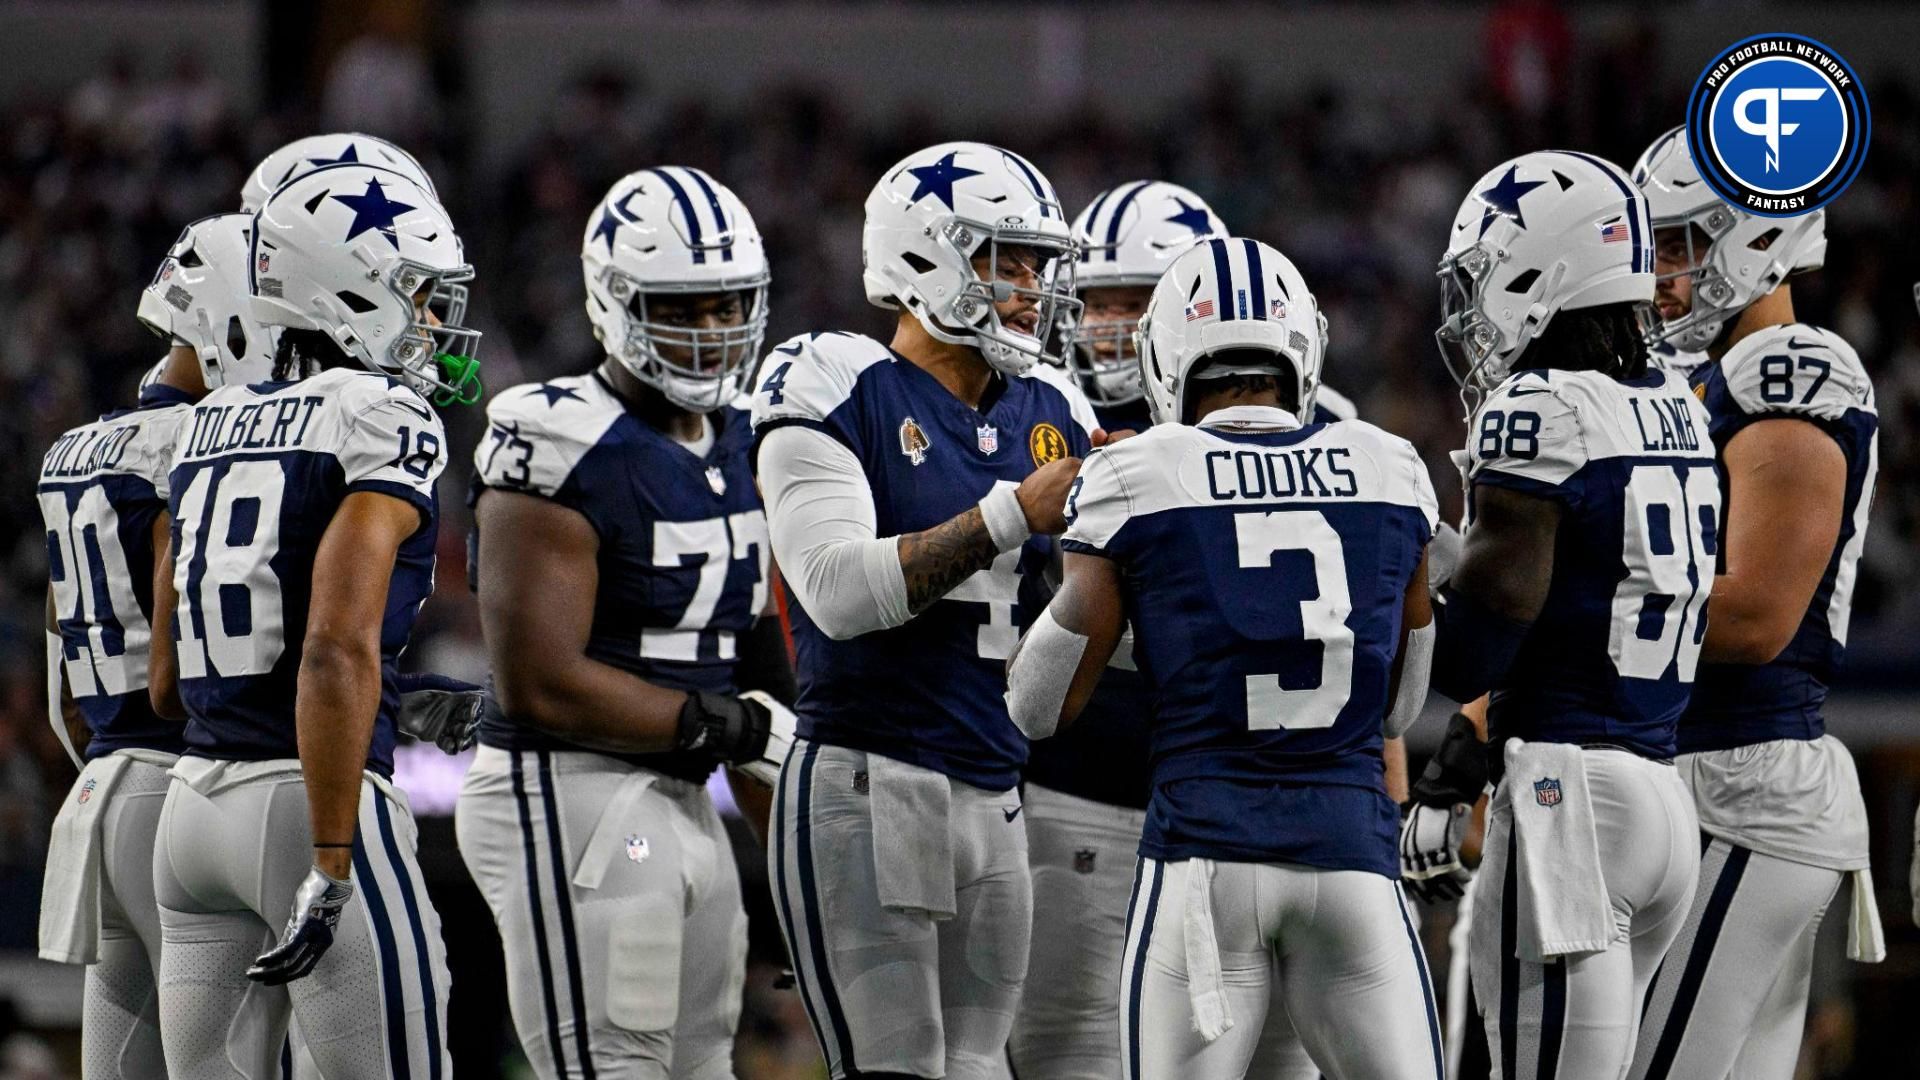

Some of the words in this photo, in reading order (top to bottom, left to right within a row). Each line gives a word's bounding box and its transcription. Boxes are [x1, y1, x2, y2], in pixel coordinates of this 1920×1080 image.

[762, 361, 792, 405] 4
[1759, 354, 1831, 405] 87
[184, 396, 325, 459] TOLBERT
[1478, 410, 1541, 460] 88
[1628, 397, 1700, 451] LAMB
[388, 425, 440, 479] 18
[485, 428, 534, 487] 73
[1205, 447, 1359, 501] COOKS
[173, 459, 286, 680] 18
[1607, 465, 1722, 683] 88
[1233, 510, 1355, 731] 3
